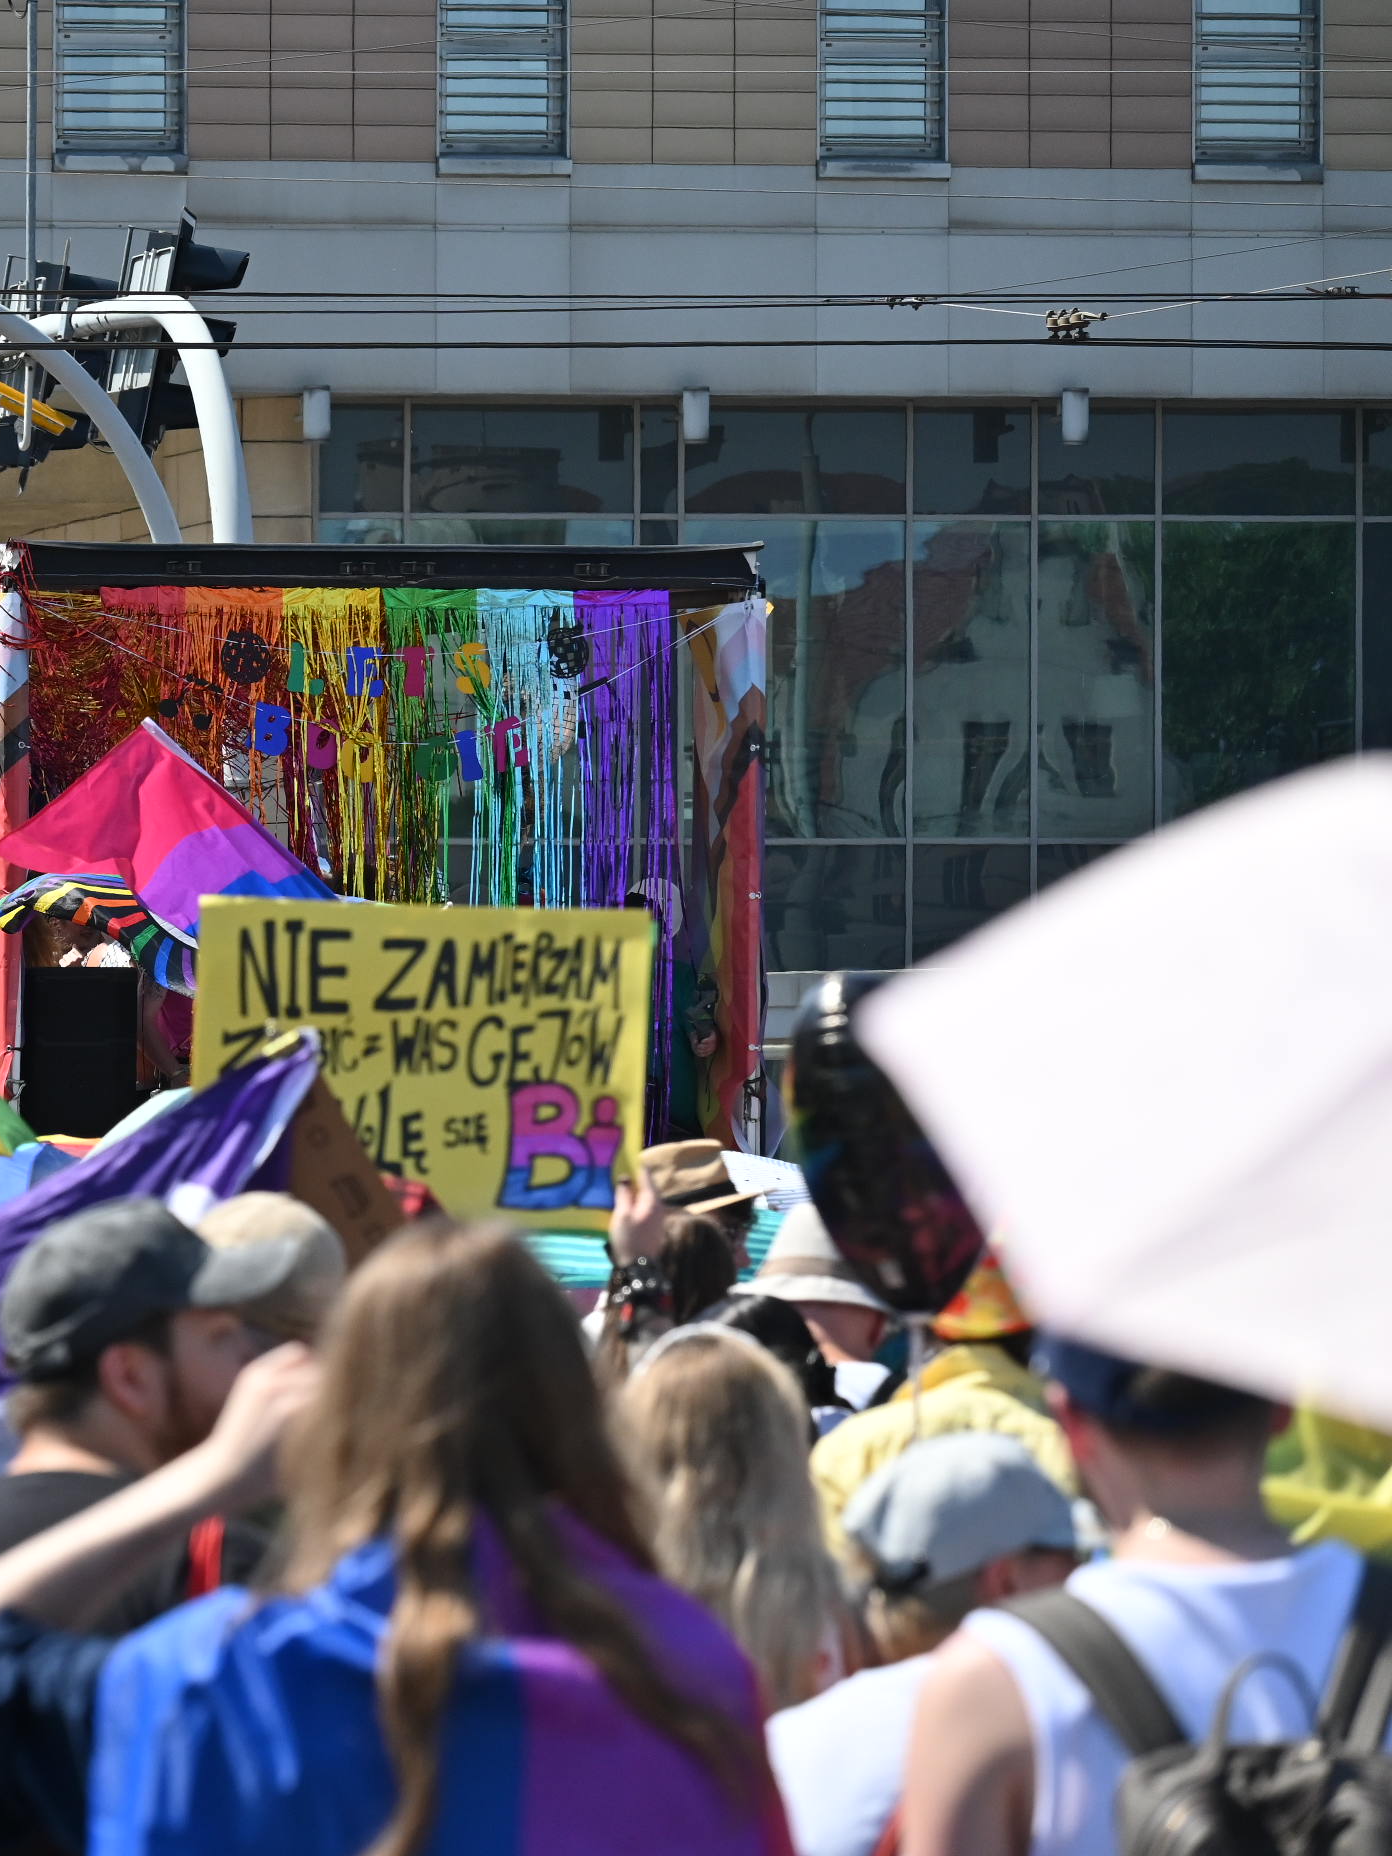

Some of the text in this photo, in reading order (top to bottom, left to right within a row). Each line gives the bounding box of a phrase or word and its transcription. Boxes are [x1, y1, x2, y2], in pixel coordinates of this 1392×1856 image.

[287, 642, 491, 699] LETS
[238, 919, 622, 1018] NIE ZAMIERZAM
[220, 1013, 359, 1076] ZBIĆ
[391, 1015, 459, 1076] WAS
[467, 1006, 624, 1090] GEJÓW
[443, 1114, 490, 1154] SIĘ
